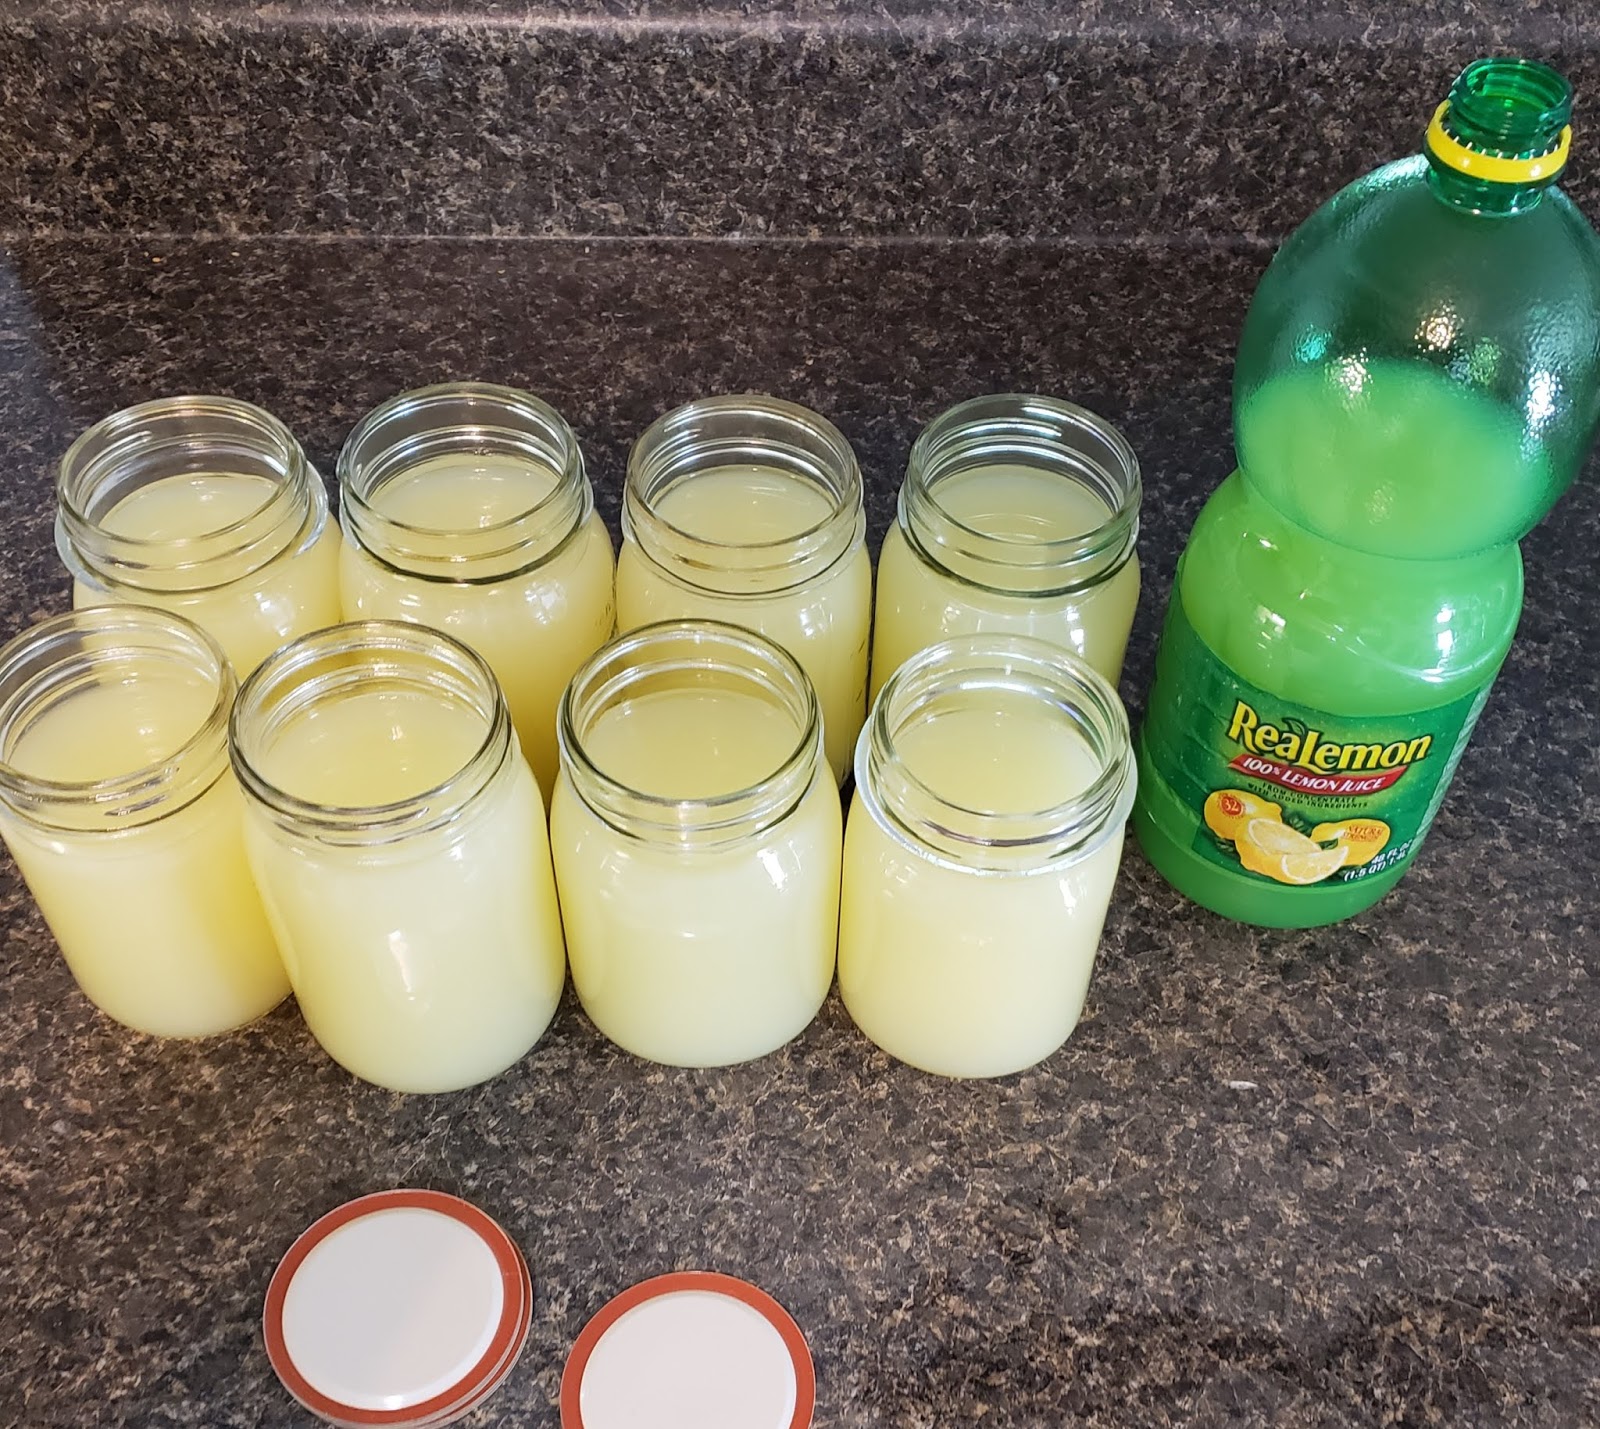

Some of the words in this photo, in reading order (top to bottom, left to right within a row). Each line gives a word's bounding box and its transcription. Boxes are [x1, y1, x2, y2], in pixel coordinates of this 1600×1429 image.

[1227, 700, 1432, 775] ReaLemon
[1242, 757, 1282, 776] 100%
[1281, 770, 1338, 791] LEMON
[1338, 776, 1386, 792] JUICE
[1248, 783, 1269, 796] WITH
[1272, 793, 1304, 805] ADDED
[1306, 801, 1368, 809] INGREDIENTS
[1262, 782, 1288, 795] FROM
[1290, 791, 1356, 804] CONCENTRATE
[1223, 797, 1239, 812] 32
[1387, 848, 1398, 859] FL
[1344, 867, 1367, 882] (1.5
[1368, 861, 1386, 874] QT)
